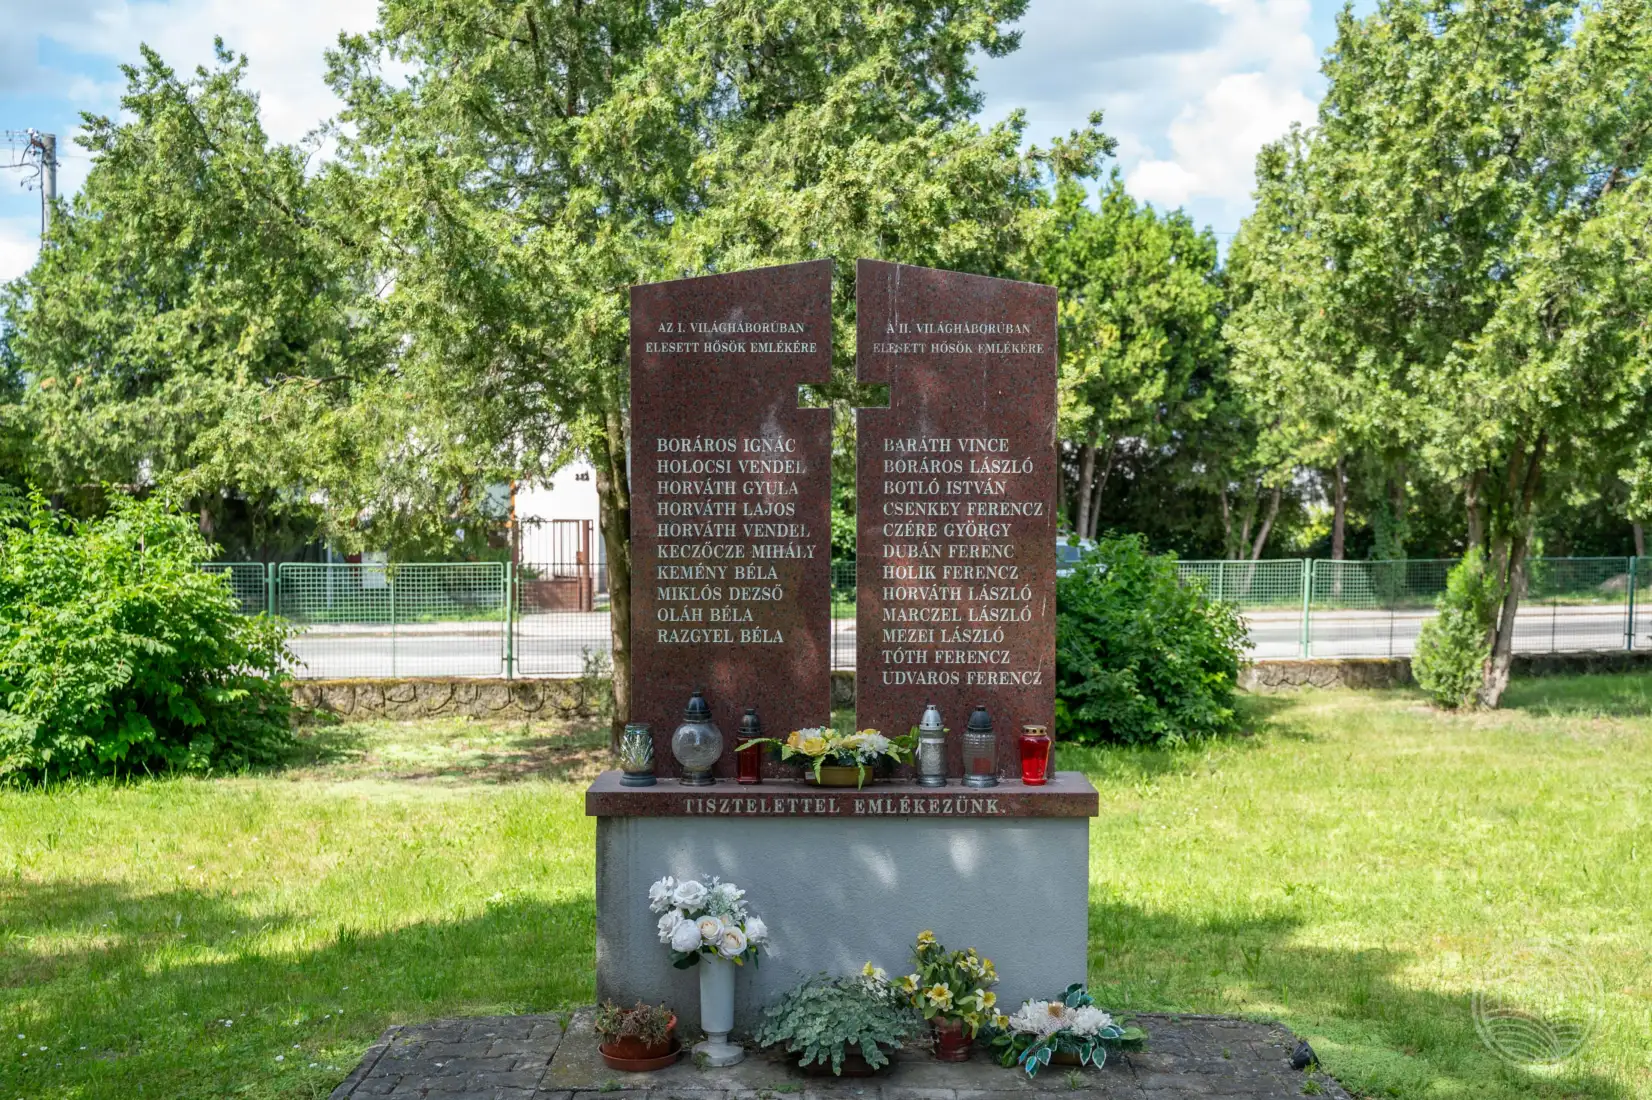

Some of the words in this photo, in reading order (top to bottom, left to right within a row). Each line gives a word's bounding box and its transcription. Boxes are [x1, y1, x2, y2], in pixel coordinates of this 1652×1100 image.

[659, 323, 673, 333] AZ
[677, 323, 686, 333] I.
[691, 320, 805, 333] VILÁGHÁBORÚBAN
[887, 324, 894, 333] A
[899, 324, 911, 333] II.
[916, 321, 1030, 333] VILÁGHÁBORÚBAN
[646, 343, 700, 353] ELESETT
[751, 341, 816, 353] EMLÉKÉRE
[873, 343, 926, 353] ELESETT
[979, 342, 1044, 353] EMLÉKÉRE
[657, 435, 736, 453] BORÁROS
[744, 435, 796, 453] IGNÁC
[884, 435, 951, 452] BARÁTH
[959, 438, 1009, 452] VINCE
[657, 460, 731, 474] HOLOCSI
[738, 460, 805, 474] VENDEL
[884, 457, 963, 473] BORÁROS
[970, 457, 1033, 473] LÁSZLÓ
[657, 478, 736, 495] HORVÁTH
[743, 481, 798, 495] GYULA
[884, 478, 939, 495] BOTLÓ
[947, 478, 1006, 495] ISTVÁN
[657, 499, 736, 516] HORVÁTH
[743, 502, 795, 516] LAJOS
[883, 502, 960, 516] CSENKEY
[967, 502, 1043, 516] FERENCZ
[657, 520, 736, 537] HORVÁTH
[744, 523, 810, 537] VENDEL
[883, 520, 937, 537] CZÉRE
[944, 520, 1012, 537] GYÖRGY
[657, 542, 744, 559] KECZŐCZE
[752, 542, 816, 559] MIHÁLY
[883, 542, 941, 558] DUBÁN
[948, 545, 1014, 558] FERENC
[657, 563, 728, 580] KEMÉNY
[735, 563, 778, 580] BÉLA
[883, 566, 936, 579] HOLIK
[943, 566, 1019, 579] FERENCZ
[657, 584, 722, 601] MIKLÓS
[729, 584, 783, 601] DEZSŐ
[883, 584, 961, 600] HORVÁTH
[968, 584, 1032, 600] LÁSZLÓ
[657, 605, 703, 622] OLÁH
[710, 605, 753, 622] BÉLA
[883, 608, 961, 622] MARCZEL
[968, 605, 1032, 622] LÁSZLÓ
[657, 629, 734, 643] RAZGYEL
[740, 626, 784, 643] BÉLA
[882, 629, 934, 643] MEZEI
[941, 626, 1004, 643] LÁSZLÓ
[882, 647, 927, 664] TÓTH
[935, 650, 1010, 664] FERENCZ
[882, 672, 960, 685] UDVAROS
[967, 672, 1042, 685] FERENCZ
[684, 798, 840, 813] TISZTELETTEL
[855, 796, 1006, 814] EMLÉKEZÜNK.
